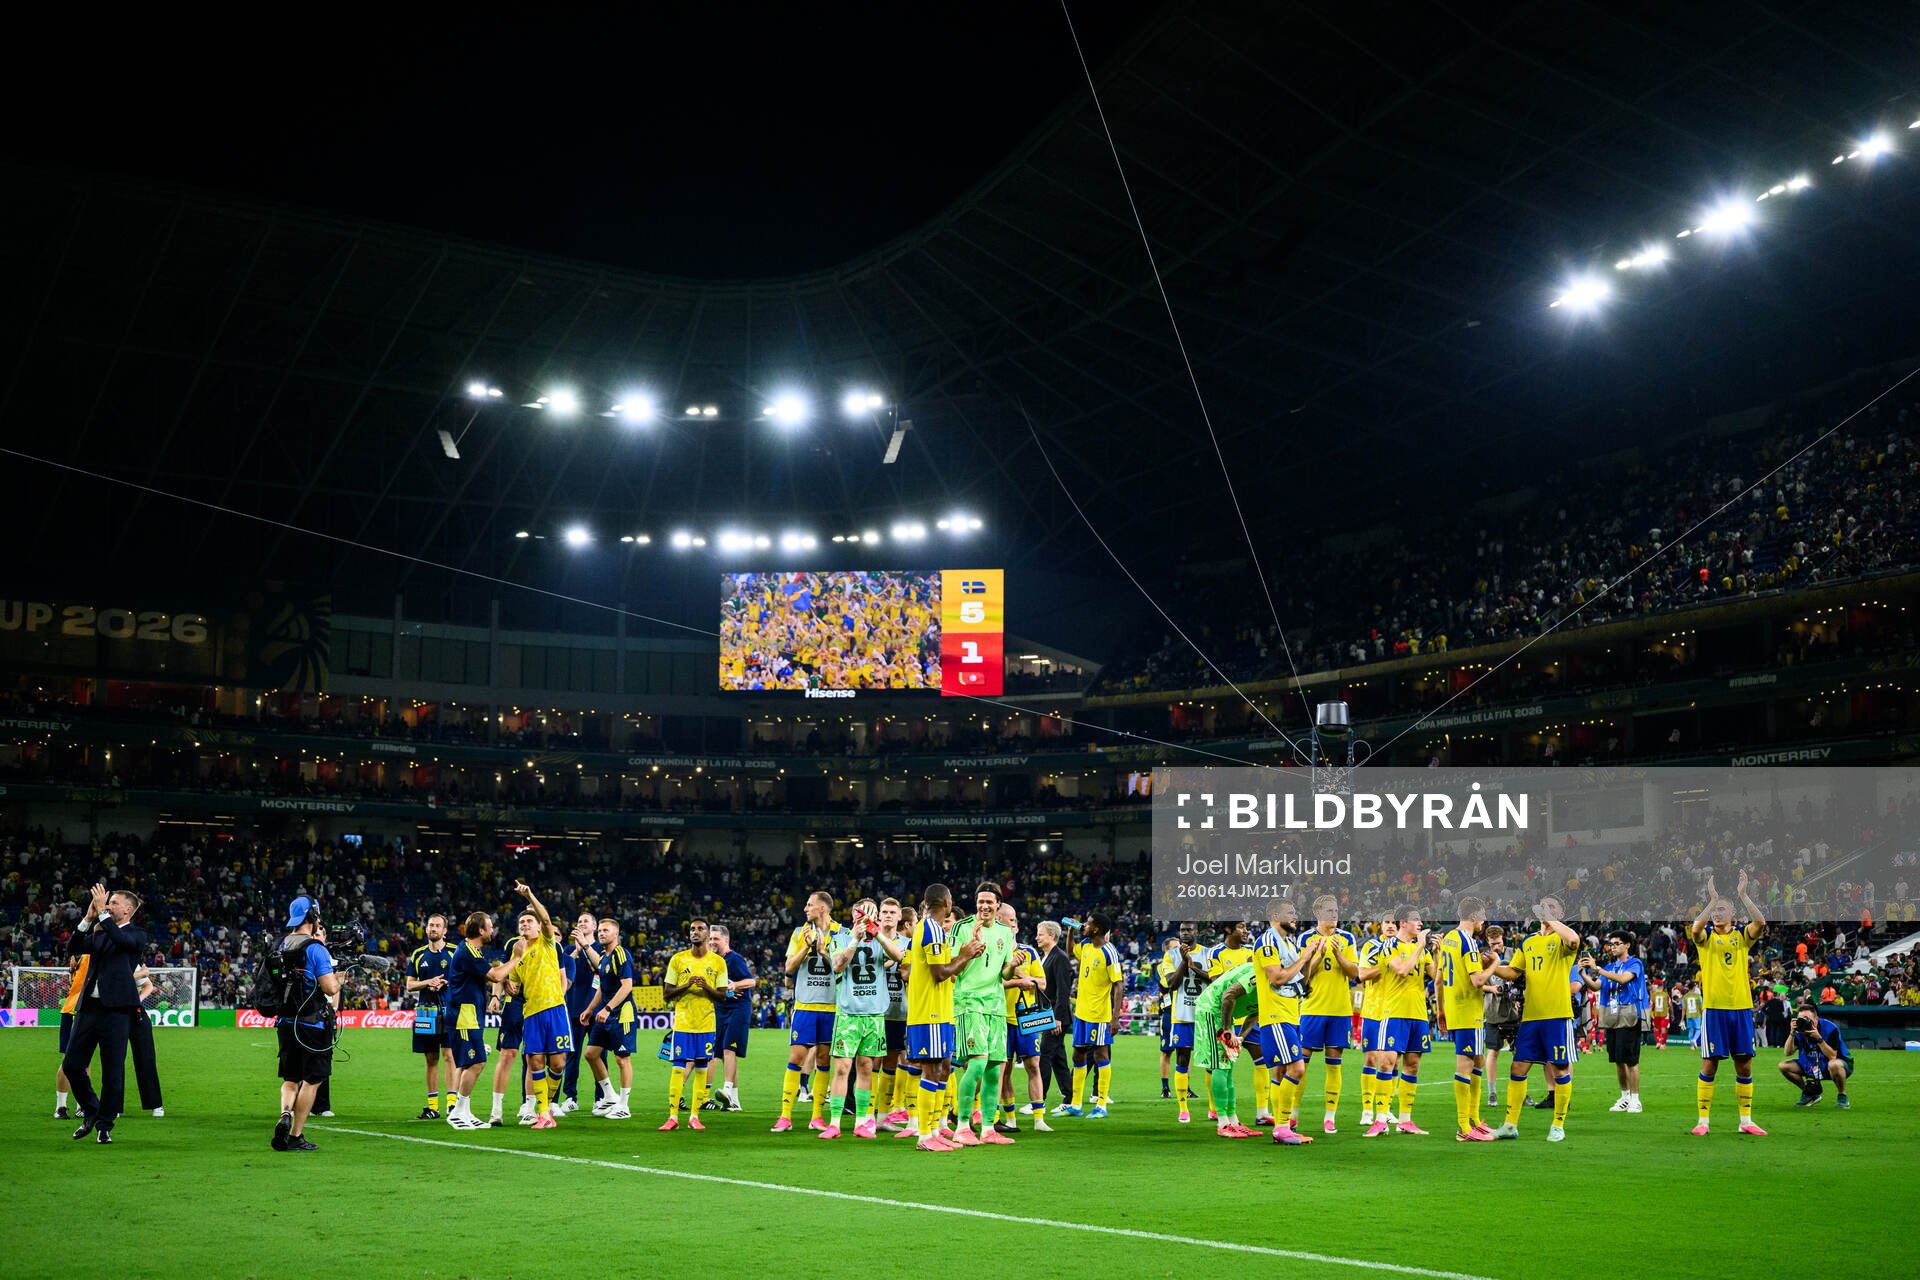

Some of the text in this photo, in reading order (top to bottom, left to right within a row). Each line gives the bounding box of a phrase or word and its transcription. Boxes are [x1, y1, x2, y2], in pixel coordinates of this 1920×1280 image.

[960, 602, 984, 623] 5
[0, 600, 208, 645] UP 2026
[961, 641, 983, 663] 1
[804, 687, 856, 698] Hisense
[1415, 705, 1544, 731] COPA MUNDIAL DE LA FIFA 2026
[628, 758, 777, 769] COPA MUNDIAL DE LA FIFA 2026
[943, 757, 1029, 767] MONTERREY
[1731, 747, 1832, 767] MONTERREY
[261, 799, 355, 813] MONTERREY
[904, 815, 1046, 827] COPA MUNDIAL DE LA FIFA 2026
[986, 953, 990, 967] 1
[1325, 957, 1332, 971] 6
[1532, 956, 1544, 971] 17
[1725, 952, 1733, 966] 2
[1085, 966, 1090, 978] 9
[361, 1010, 415, 1028] Coca-Cola
[1022, 1017, 1052, 1029] POWERADE
[556, 1035, 570, 1050] 22
[705, 1042, 713, 1056] 2
[877, 1037, 887, 1052] 12
[1553, 1046, 1566, 1060] 17
